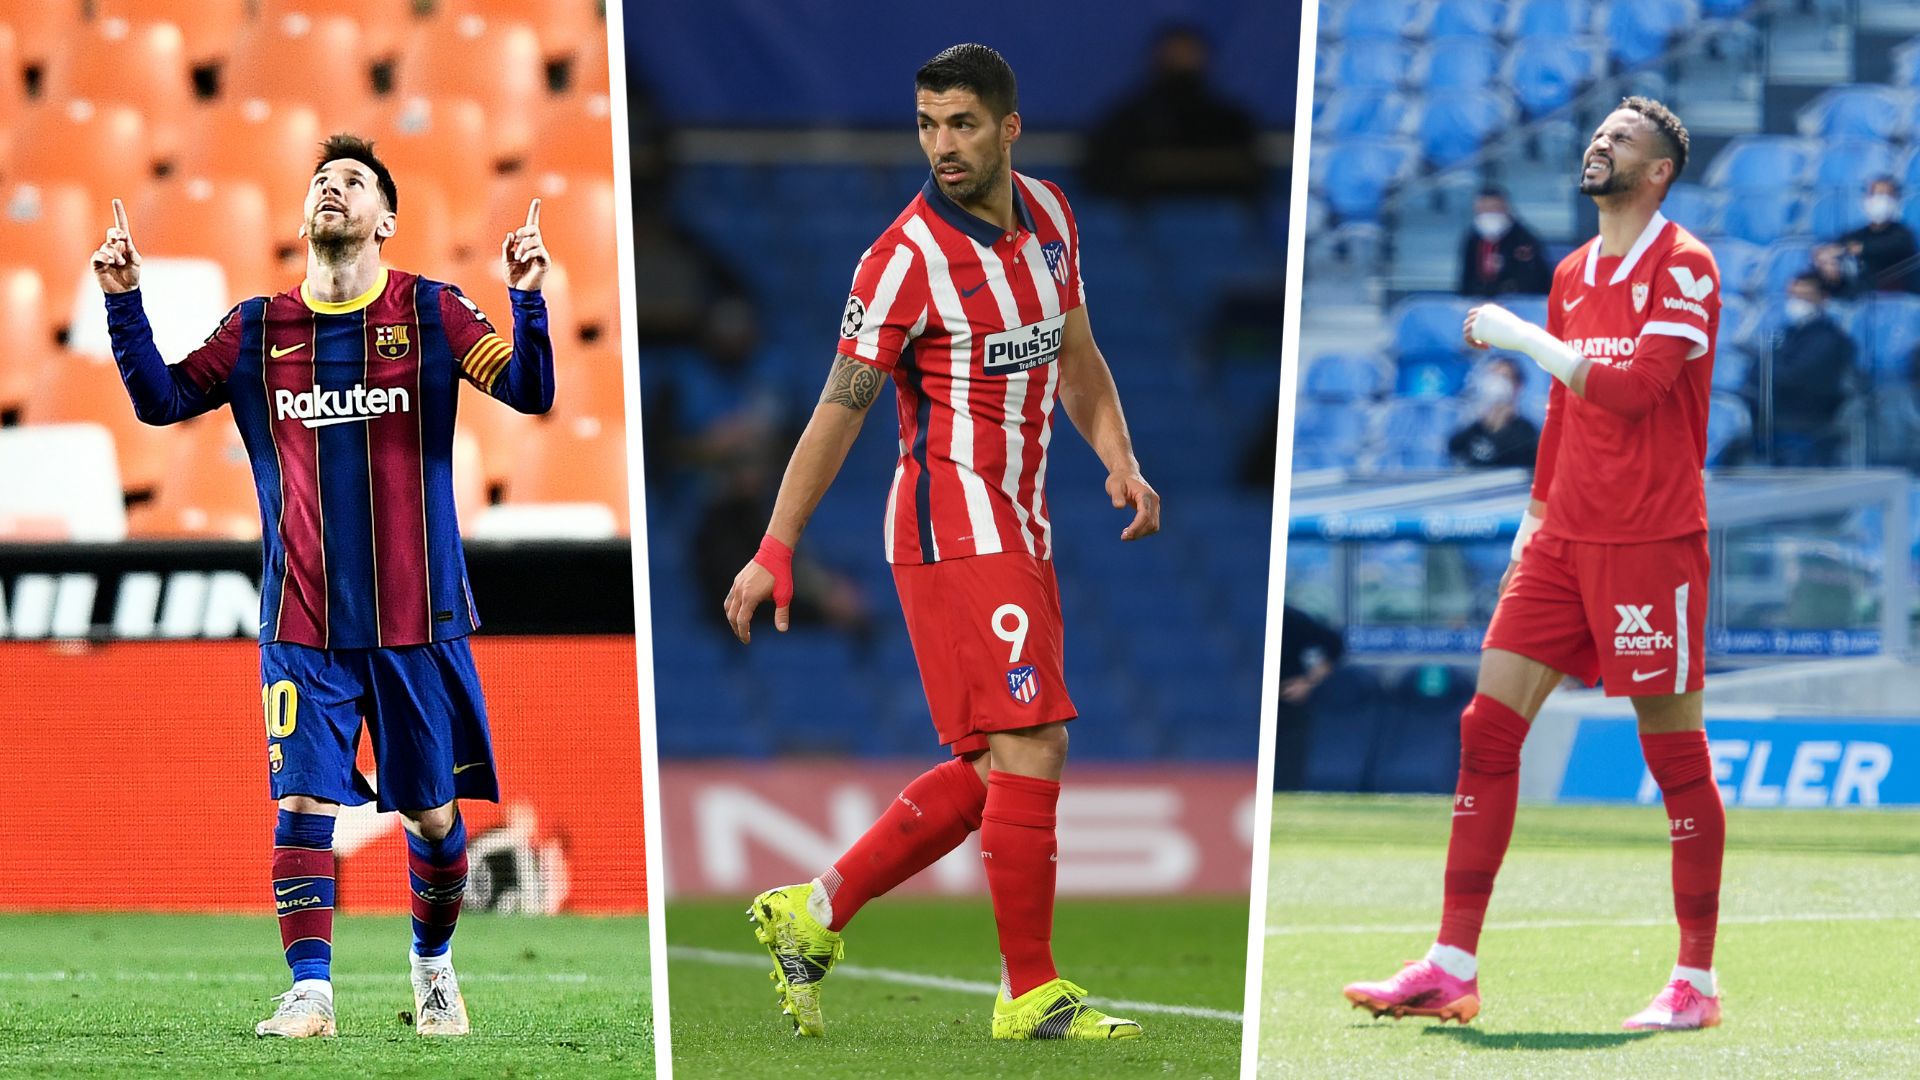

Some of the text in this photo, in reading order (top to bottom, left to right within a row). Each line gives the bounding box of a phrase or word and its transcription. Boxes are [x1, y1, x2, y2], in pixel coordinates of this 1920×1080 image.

[989, 325, 1065, 364] Plus50
[1564, 336, 1640, 356] RATHO
[275, 384, 410, 421] Rakuten
[991, 603, 1029, 663] 9
[1614, 630, 1674, 649] everfx
[1637, 740, 1893, 807] ELER
